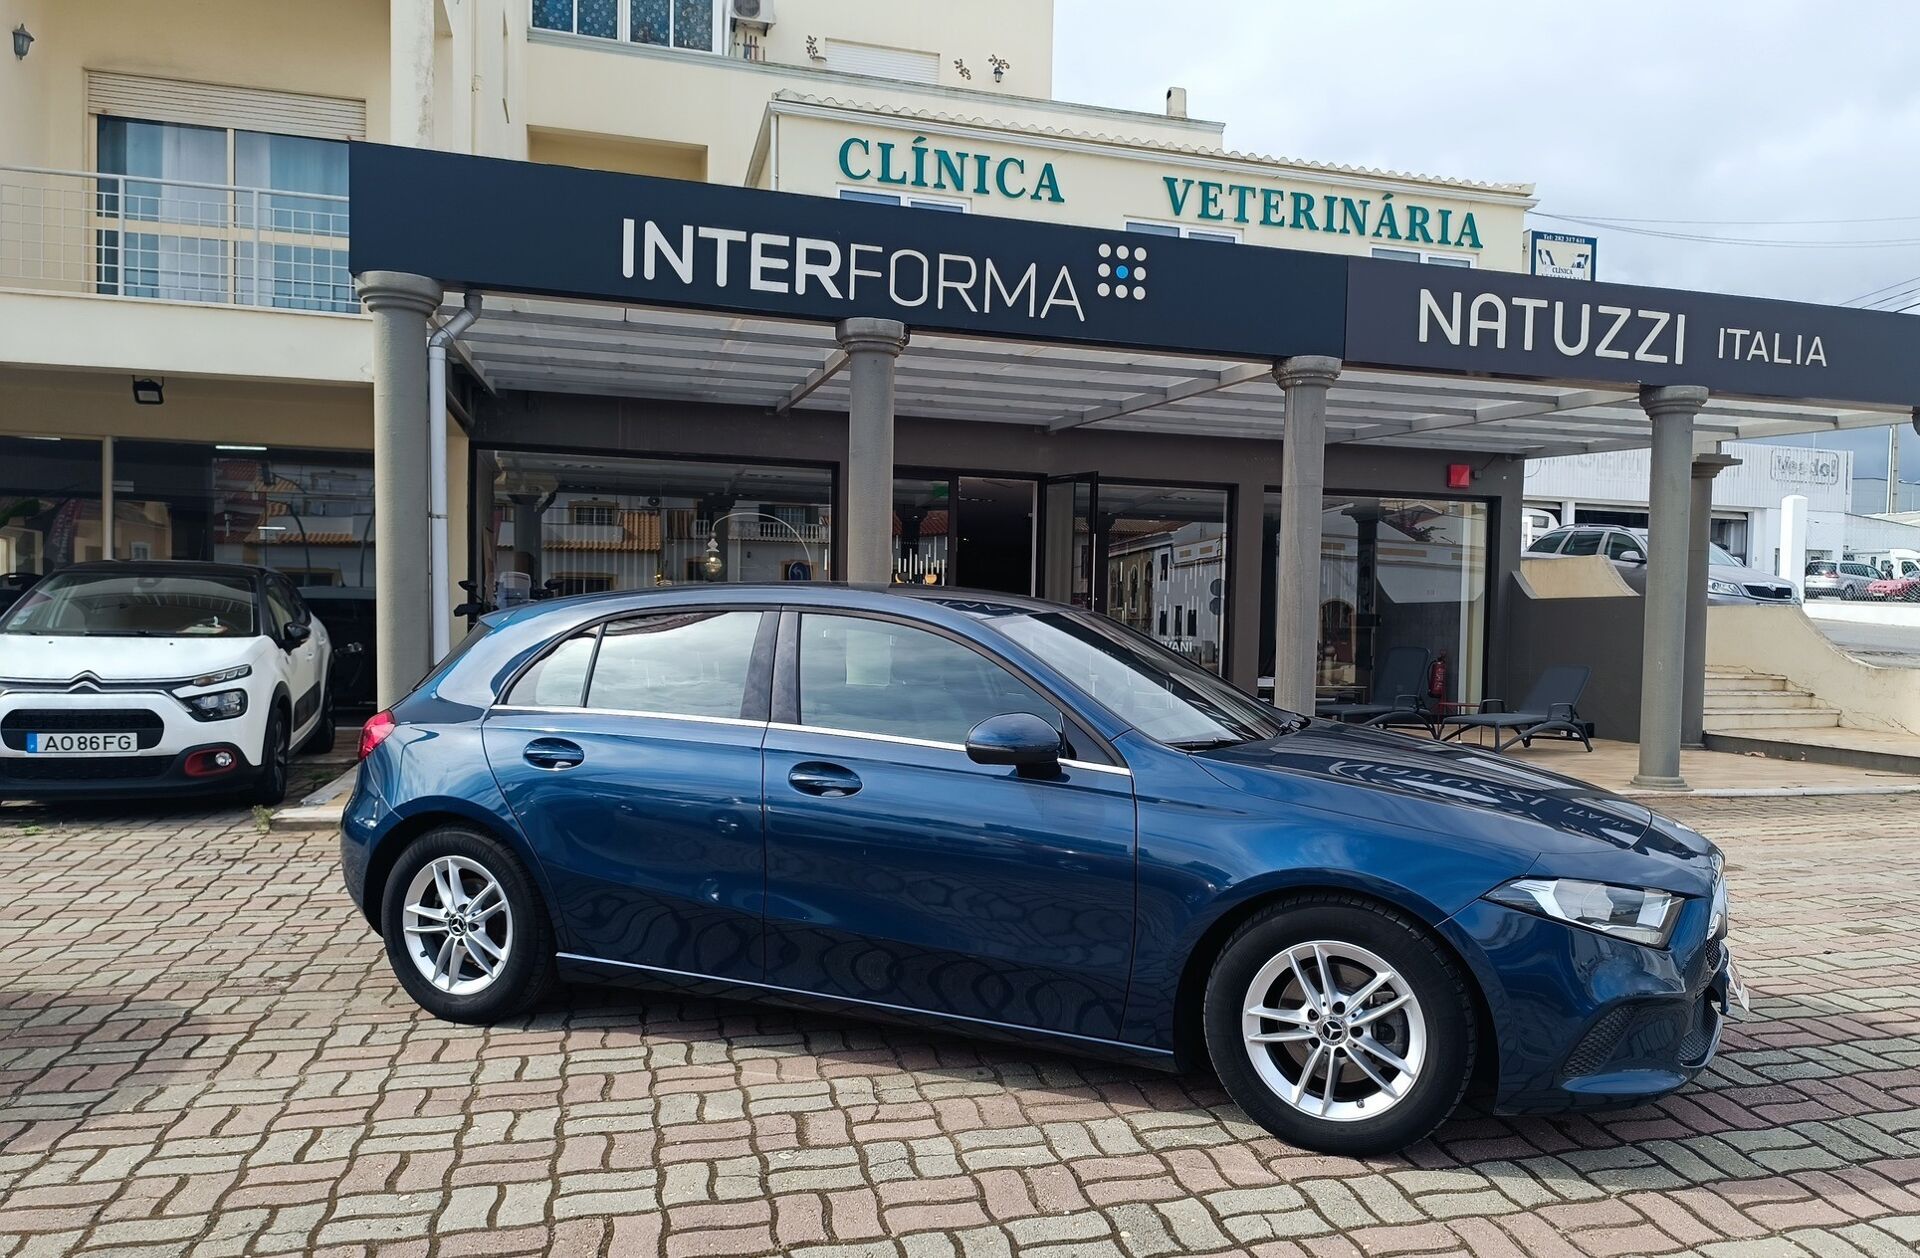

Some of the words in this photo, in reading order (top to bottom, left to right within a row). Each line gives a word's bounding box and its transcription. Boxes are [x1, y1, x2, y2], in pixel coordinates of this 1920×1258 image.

[838, 136, 1065, 203] CLÍNICA
[1164, 177, 1484, 249] VETERINÁRIA
[622, 218, 1086, 322] INTERFORMA
[1419, 288, 1687, 365] NATUZZI
[1718, 327, 1828, 367] ITALIA
[1161, 641, 1193, 652] VANI
